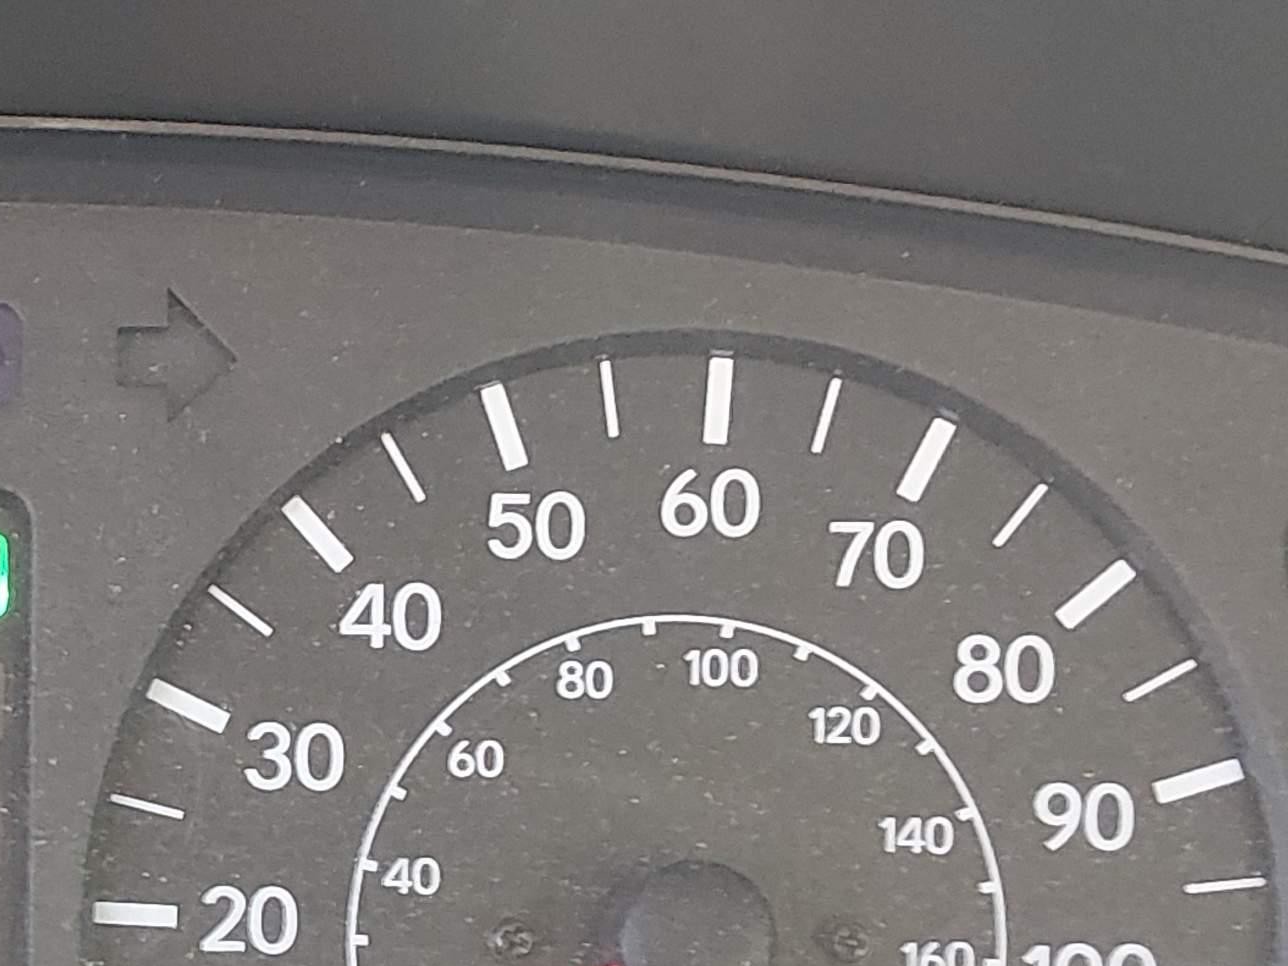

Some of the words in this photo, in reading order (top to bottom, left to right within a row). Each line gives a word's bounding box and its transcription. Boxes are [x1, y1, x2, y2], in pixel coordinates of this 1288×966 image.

[488, 492, 585, 560] 50
[661, 469, 759, 537] 60
[830, 521, 923, 588] 70
[340, 583, 441, 650] 40
[557, 661, 613, 699] 80
[685, 649, 758, 687] 100
[954, 635, 1054, 703] 80
[244, 722, 344, 791] 30
[448, 740, 504, 777] 60
[809, 707, 880, 744] 120
[879, 817, 953, 854] 140
[1034, 783, 1134, 851] 90
[382, 858, 440, 895] 40
[200, 886, 297, 954] 20
